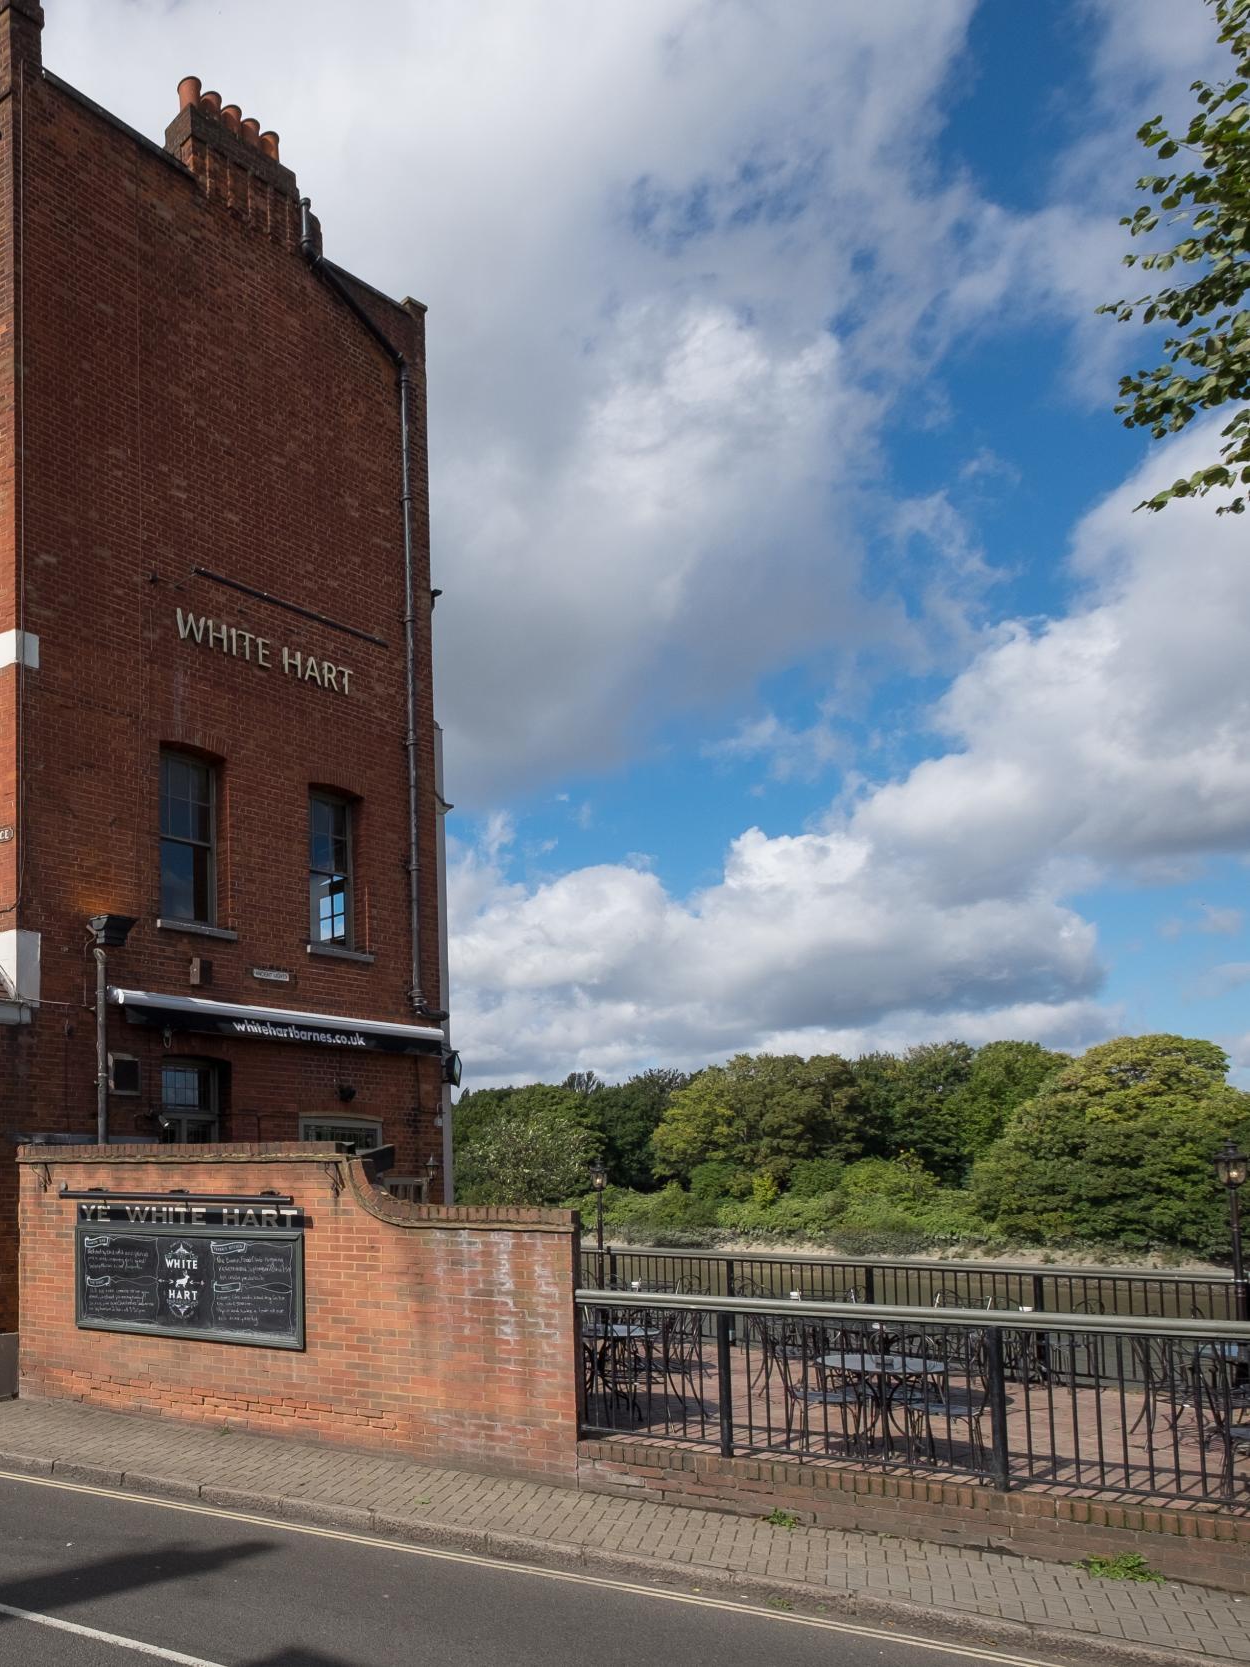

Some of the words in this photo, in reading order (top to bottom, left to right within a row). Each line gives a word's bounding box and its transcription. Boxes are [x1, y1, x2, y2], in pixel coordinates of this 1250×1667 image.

[176, 607, 272, 668] WHITE
[282, 646, 354, 695] HART
[232, 1019, 366, 1046] whitehartbarnes.co.uk
[81, 1204, 111, 1222] YE
[125, 1205, 207, 1225] WHITE
[222, 1207, 298, 1228] HART
[165, 1258, 198, 1270] WHITE
[168, 1289, 198, 1301] HART
